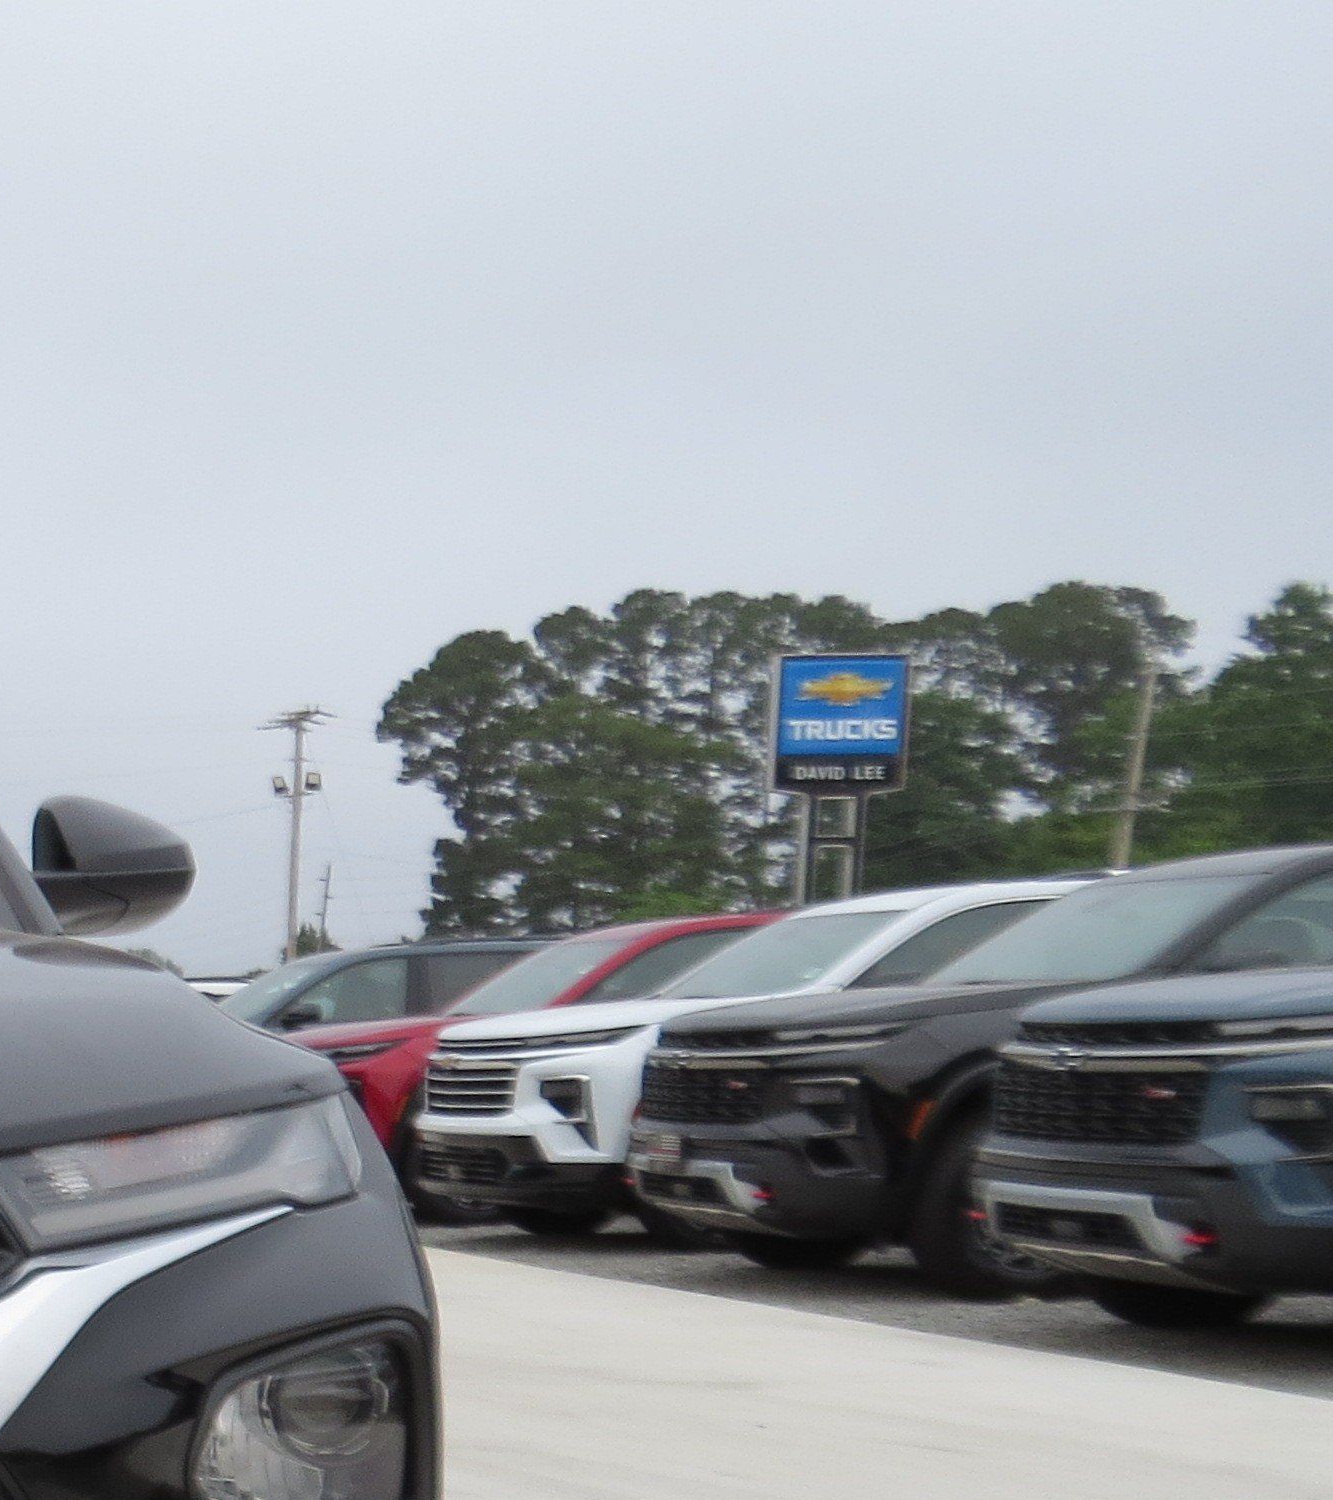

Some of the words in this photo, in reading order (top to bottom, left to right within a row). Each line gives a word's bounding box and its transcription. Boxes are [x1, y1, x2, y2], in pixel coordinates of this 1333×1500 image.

[789, 719, 897, 740] TRUCKS
[794, 766, 845, 780] DAVID
[854, 766, 886, 780] LEE
